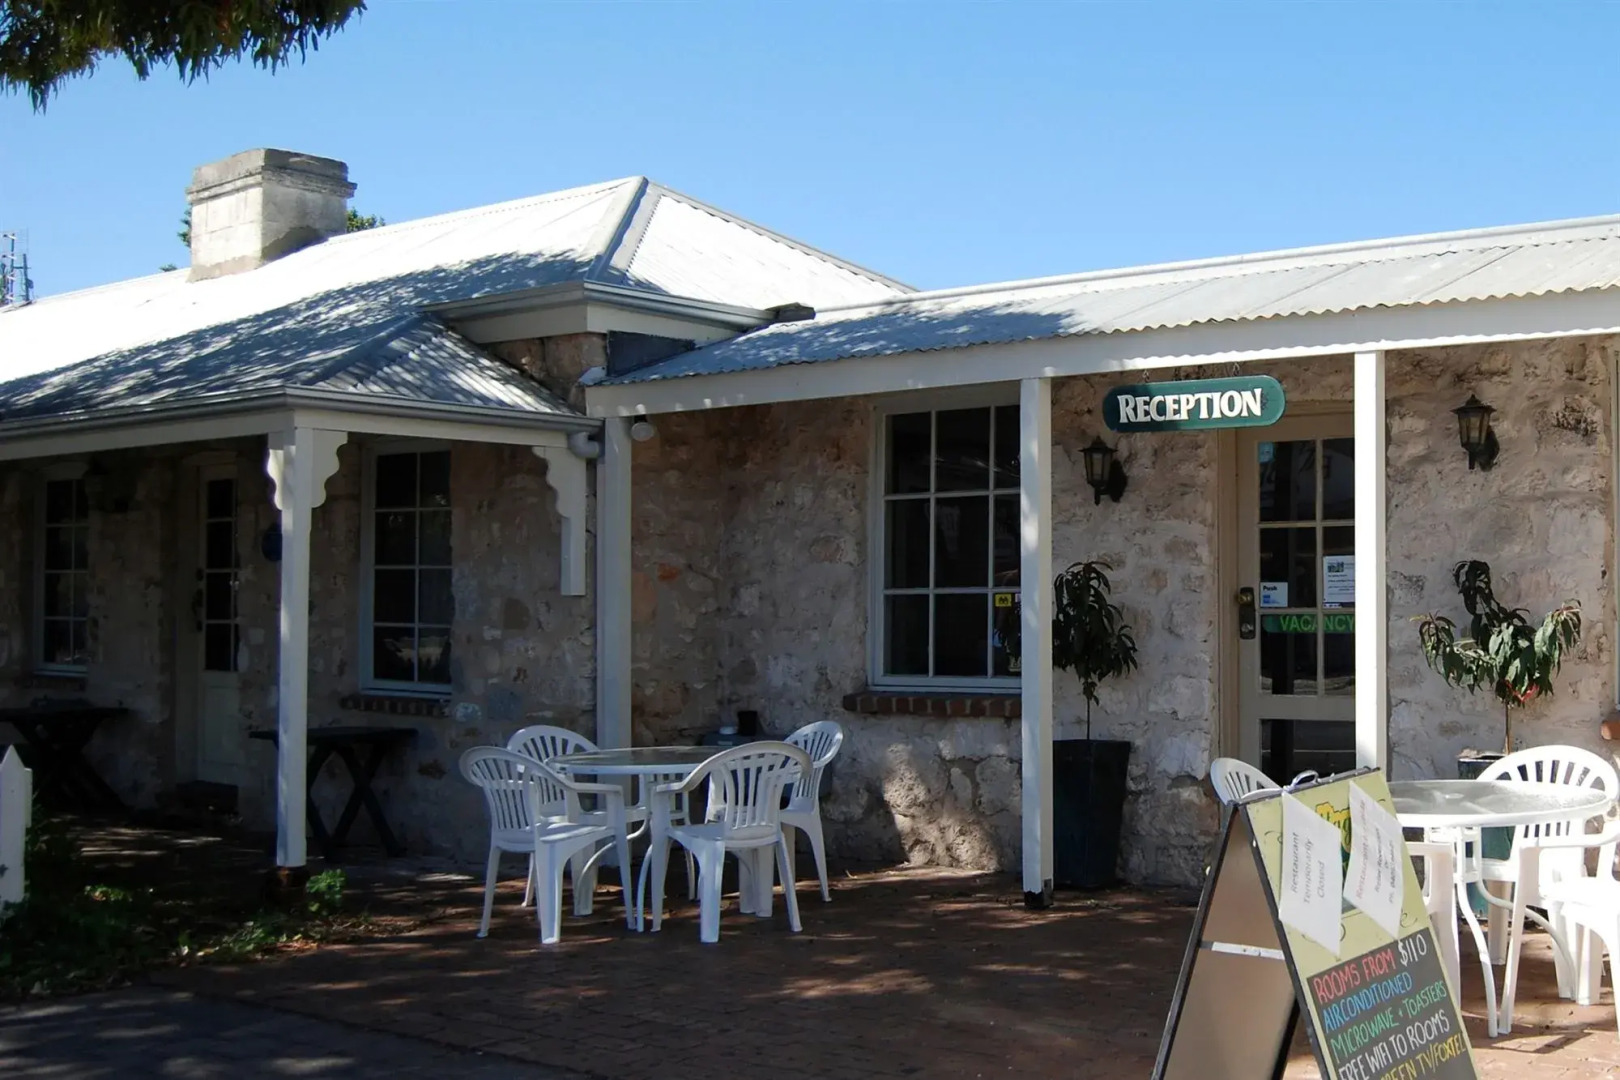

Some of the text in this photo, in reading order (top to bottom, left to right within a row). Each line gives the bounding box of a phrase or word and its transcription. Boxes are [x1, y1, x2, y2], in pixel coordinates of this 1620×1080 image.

[1117, 388, 1262, 424] RECEPTION
[1290, 832, 1299, 893] Restaurant
[1303, 839, 1314, 904] Temporarily
[1317, 860, 1325, 898] Closed
[1313, 934, 1427, 1005] ROOMS FROM $110
[1322, 972, 1413, 1033] AIRCONDITIONED
[1330, 1007, 1399, 1063] MICROWAVE
[1402, 981, 1447, 1019] TOASTERS
[1338, 1009, 1450, 1080] FREE WIFI TO ROOMS
[1415, 1032, 1467, 1075] TV/FOXTEL
